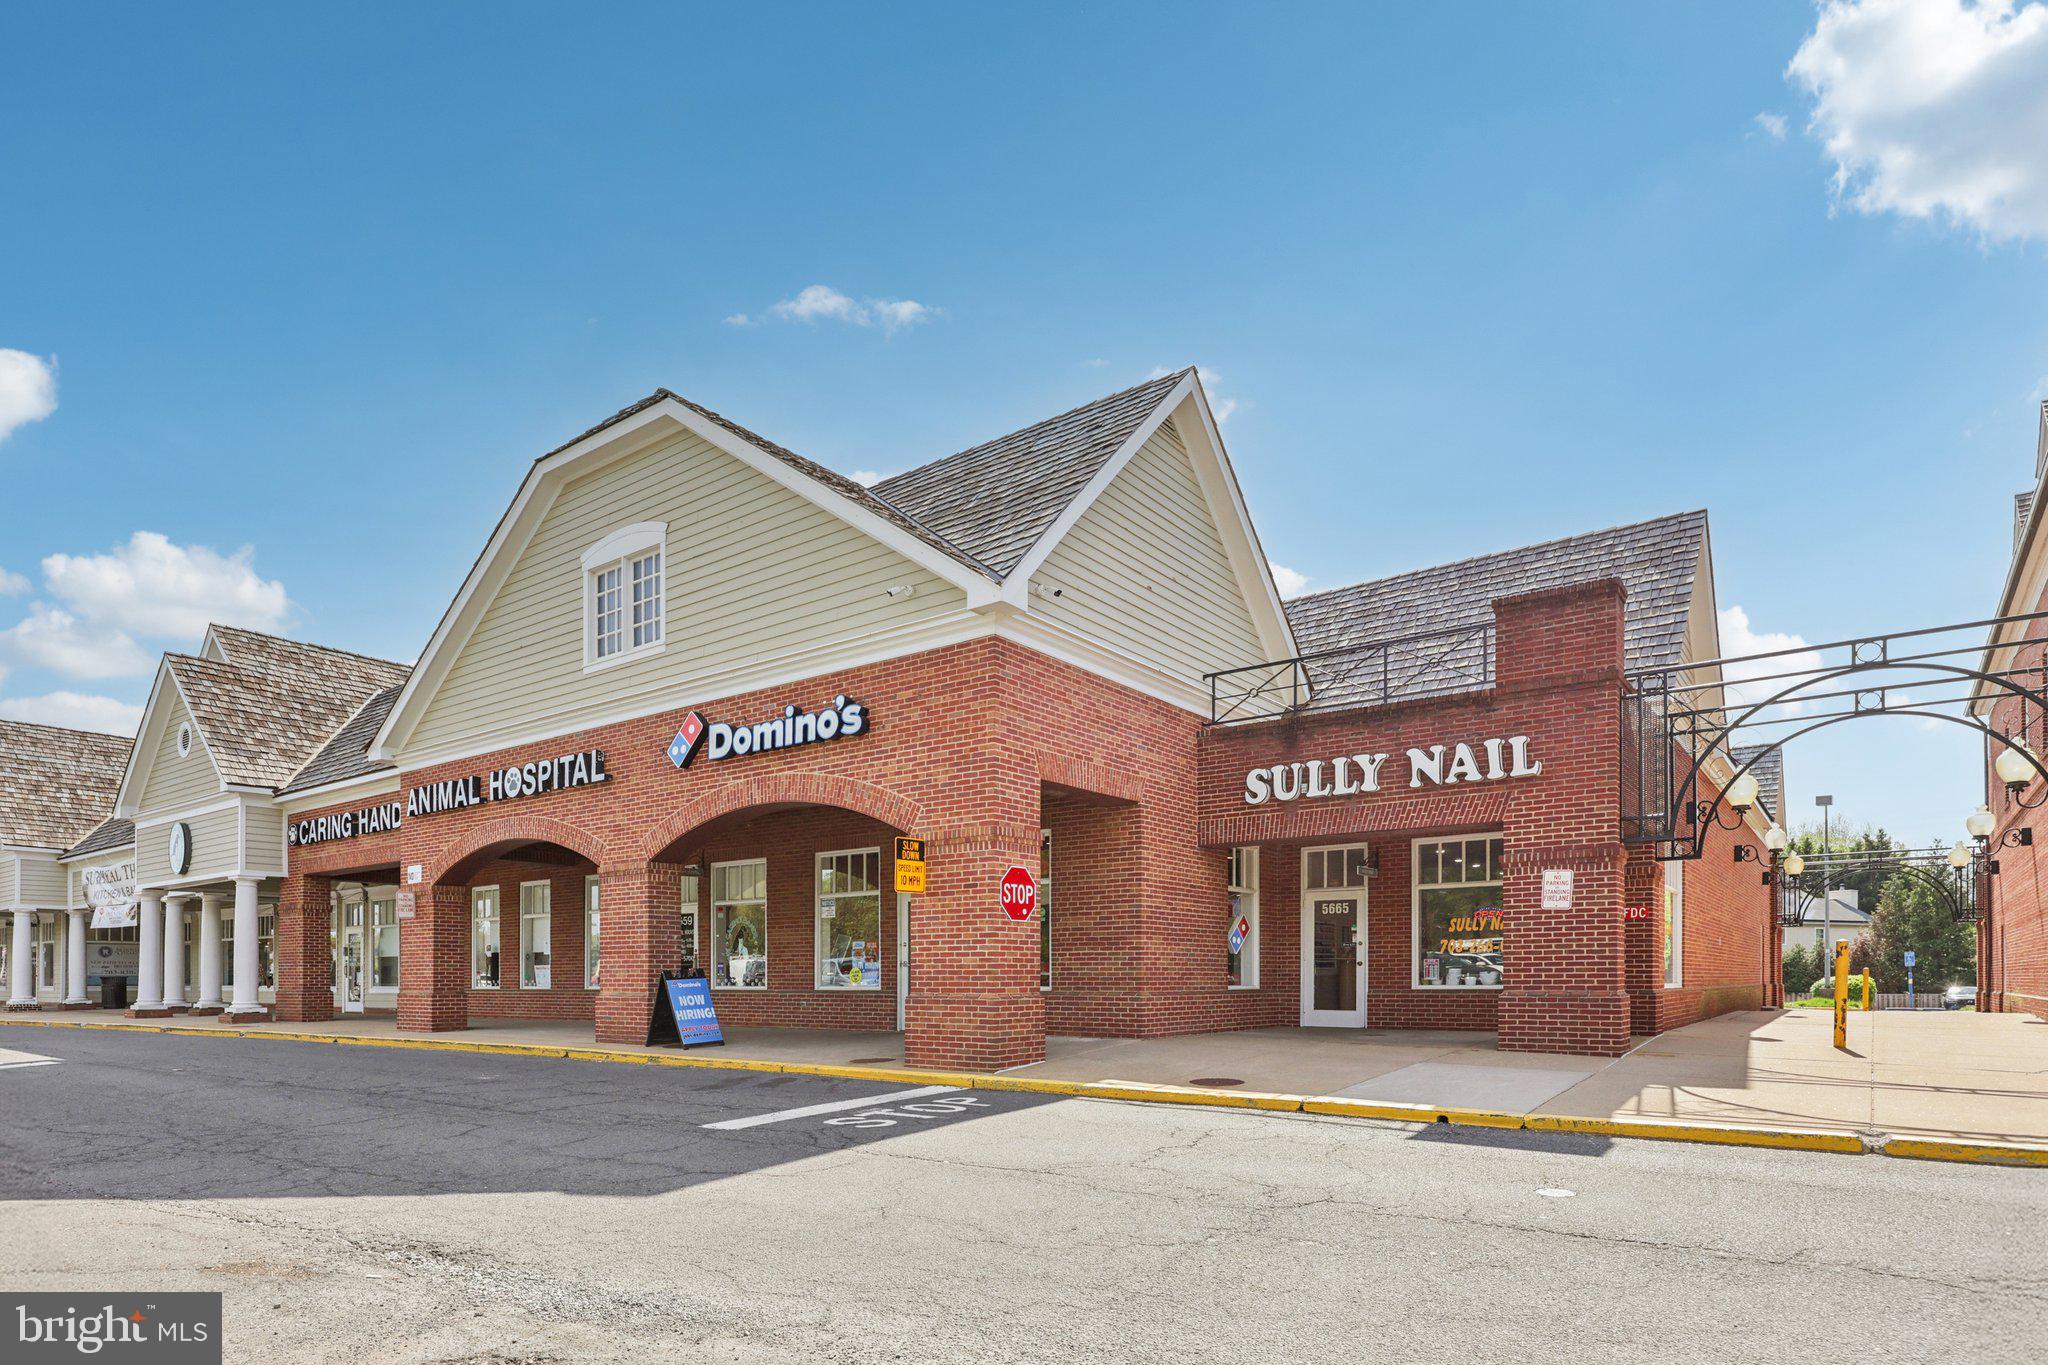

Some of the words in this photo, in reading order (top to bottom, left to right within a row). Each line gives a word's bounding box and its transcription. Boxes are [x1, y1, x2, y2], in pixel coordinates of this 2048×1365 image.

[708, 694, 862, 760] Domino's
[1245, 753, 1389, 805] SULLY
[1406, 735, 1542, 788] NAIL
[407, 776, 480, 816] ANIMAL
[489, 749, 605, 800] HOSPITAL
[299, 812, 352, 845] CARING
[902, 840, 919, 851] SLOW
[902, 850, 920, 860] DOWN
[898, 864, 911, 872] SPEED
[900, 875, 907, 885] 10
[908, 876, 920, 886] MPH
[1003, 883, 1034, 905] STOP
[1322, 902, 1350, 915] 5665
[1623, 907, 1647, 918] FDC
[680, 915, 693, 926] 59
[1448, 917, 1487, 932] SULLY
[678, 995, 705, 1006] NOW
[675, 1007, 716, 1020] HIRING!
[823, 1097, 991, 1128] STOP
